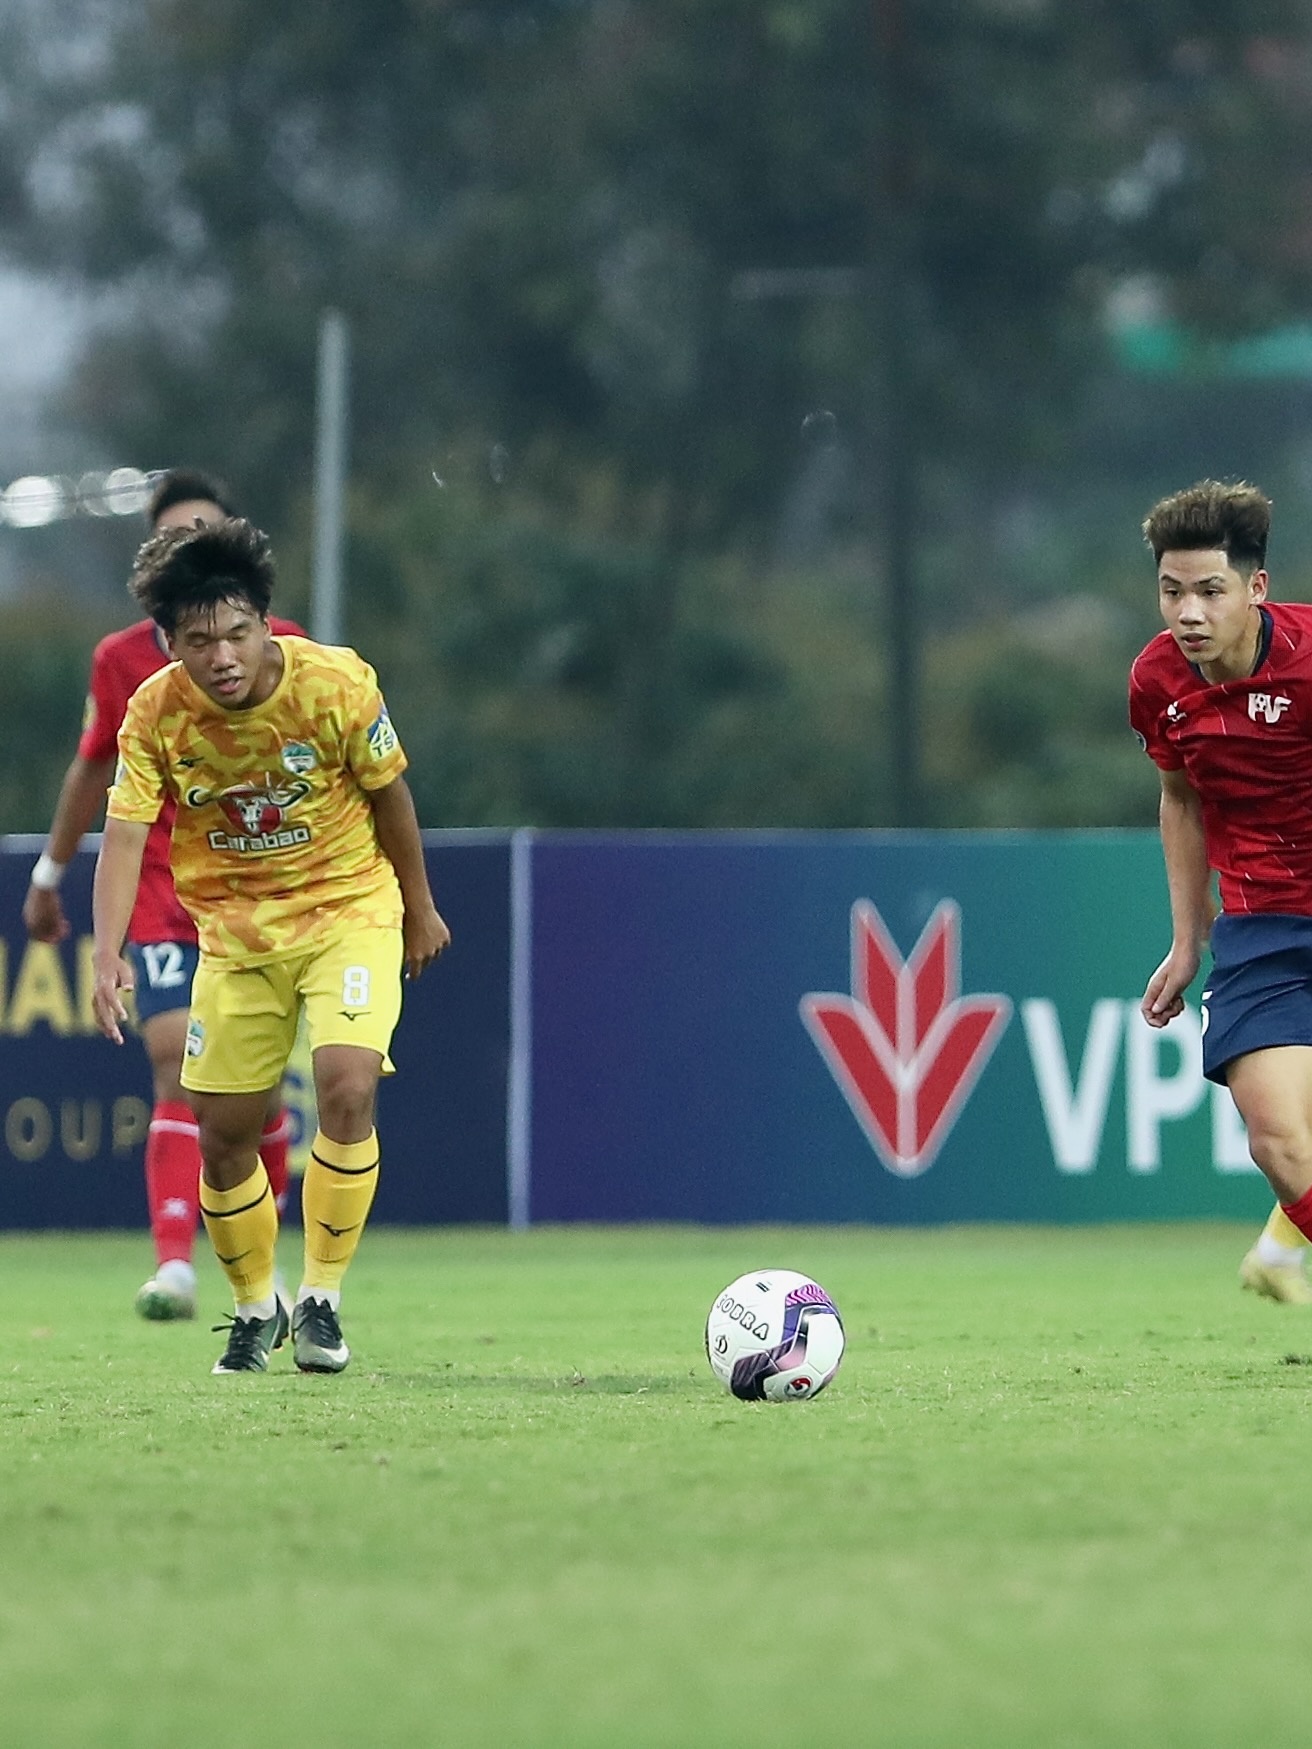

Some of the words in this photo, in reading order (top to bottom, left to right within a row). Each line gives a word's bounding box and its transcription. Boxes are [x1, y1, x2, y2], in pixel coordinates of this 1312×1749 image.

[208, 826, 311, 851] Carabao
[141, 941, 187, 989] 12
[342, 965, 370, 1007] 8
